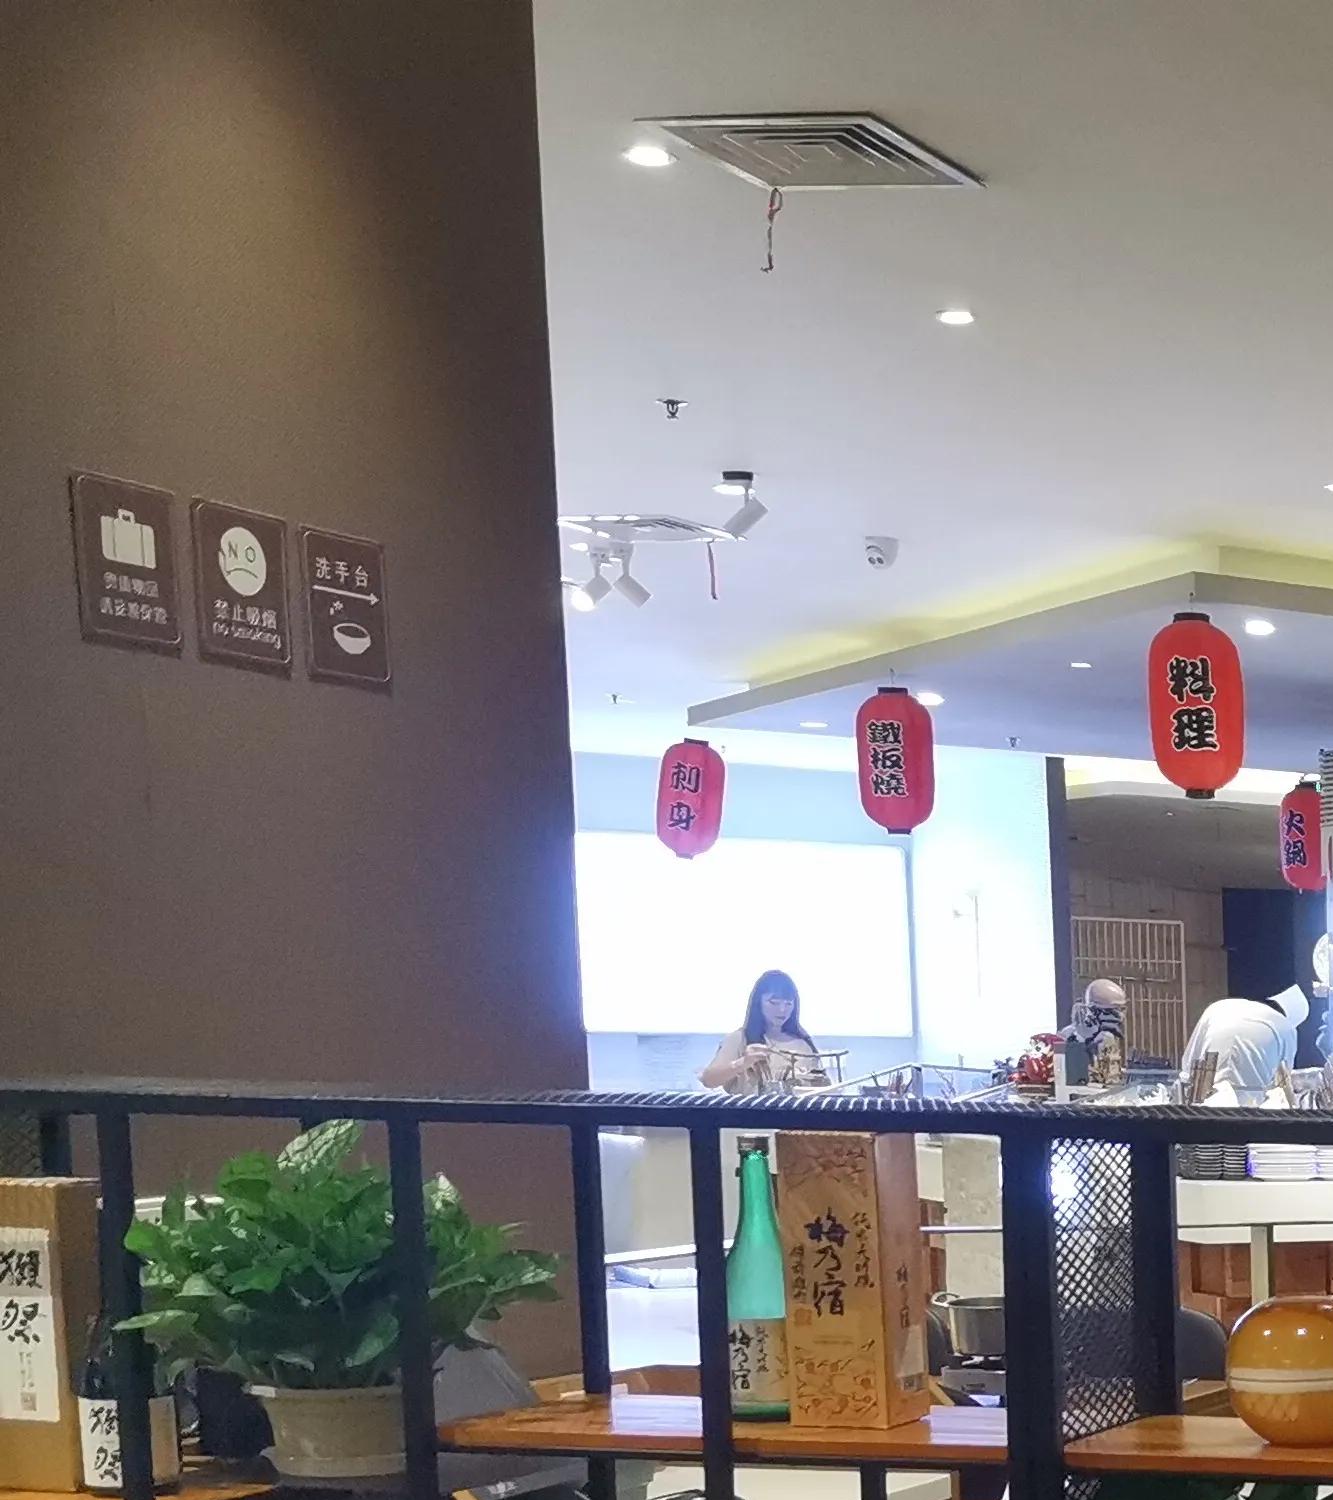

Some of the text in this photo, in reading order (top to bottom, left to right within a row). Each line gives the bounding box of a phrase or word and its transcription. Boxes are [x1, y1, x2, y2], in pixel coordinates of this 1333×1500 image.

[314, 556, 370, 588] 洗手台
[1168, 655, 1219, 751] 料理
[668, 762, 700, 832] 刺身
[804, 1207, 849, 1317] 梅乃宿
